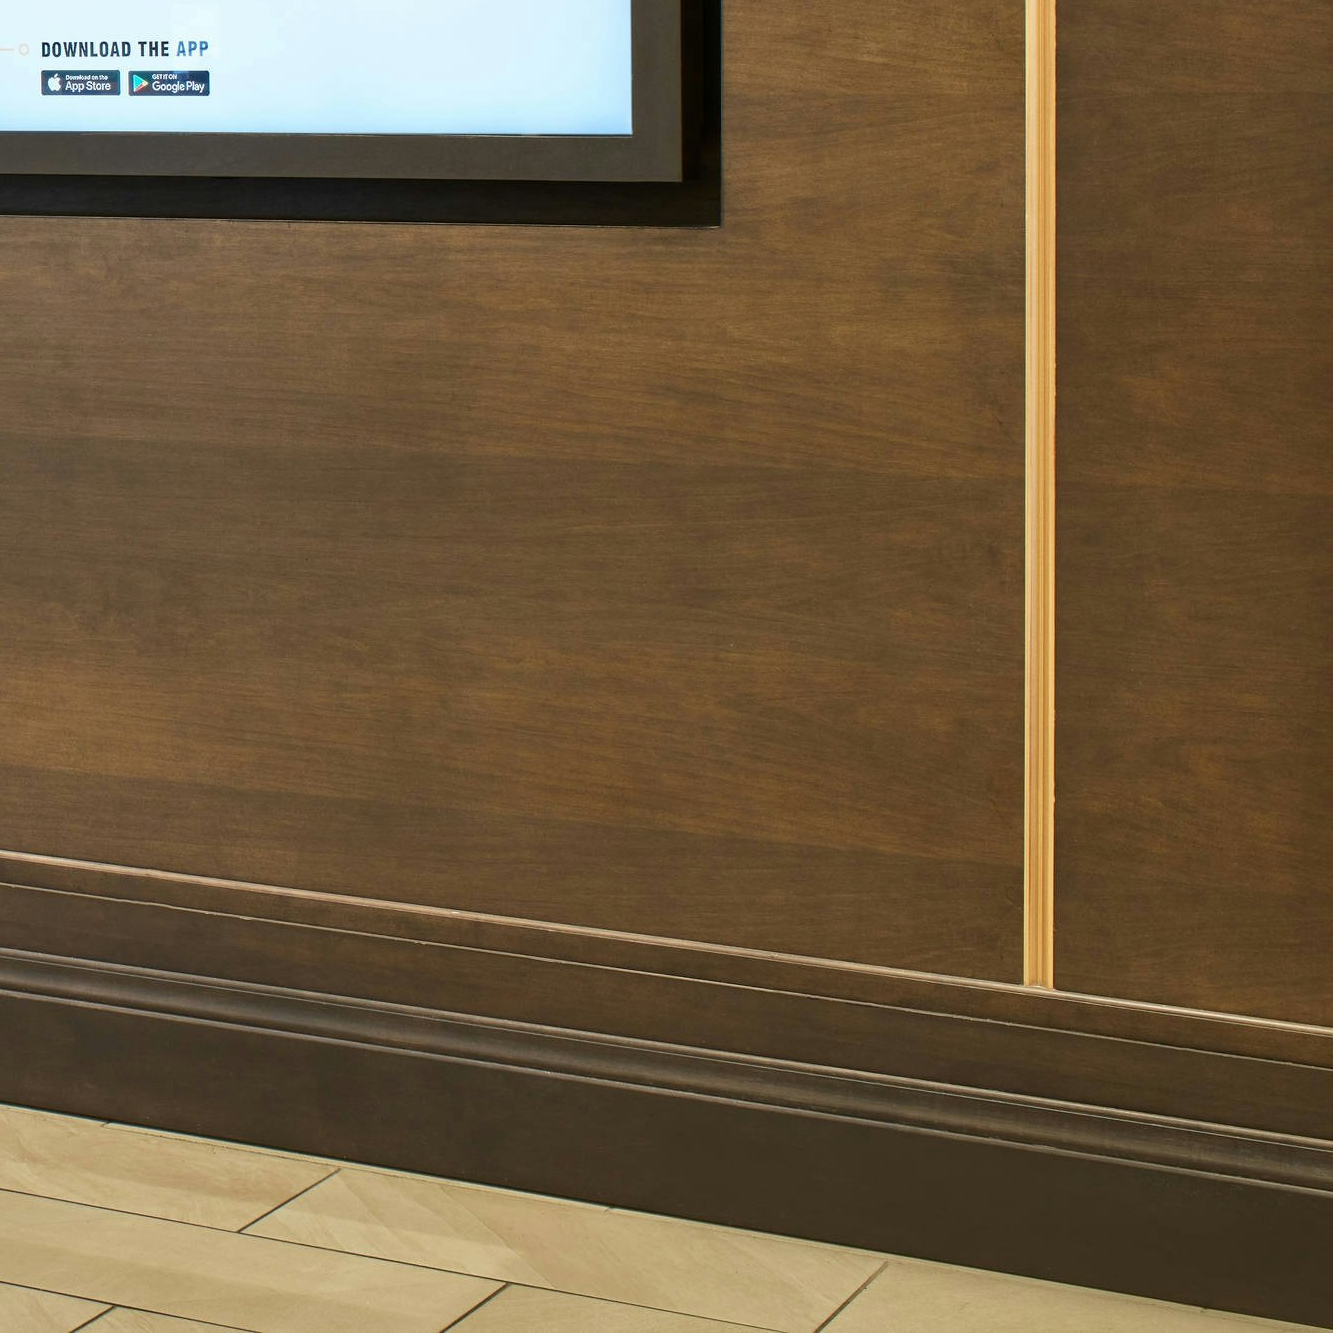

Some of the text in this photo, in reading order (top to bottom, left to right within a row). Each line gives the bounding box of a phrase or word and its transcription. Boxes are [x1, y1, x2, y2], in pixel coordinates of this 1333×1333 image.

[41, 40, 209, 58] DOWNLOAD THE APP
[65, 80, 112, 93] App Store
[152, 81, 205, 94] Google Play
